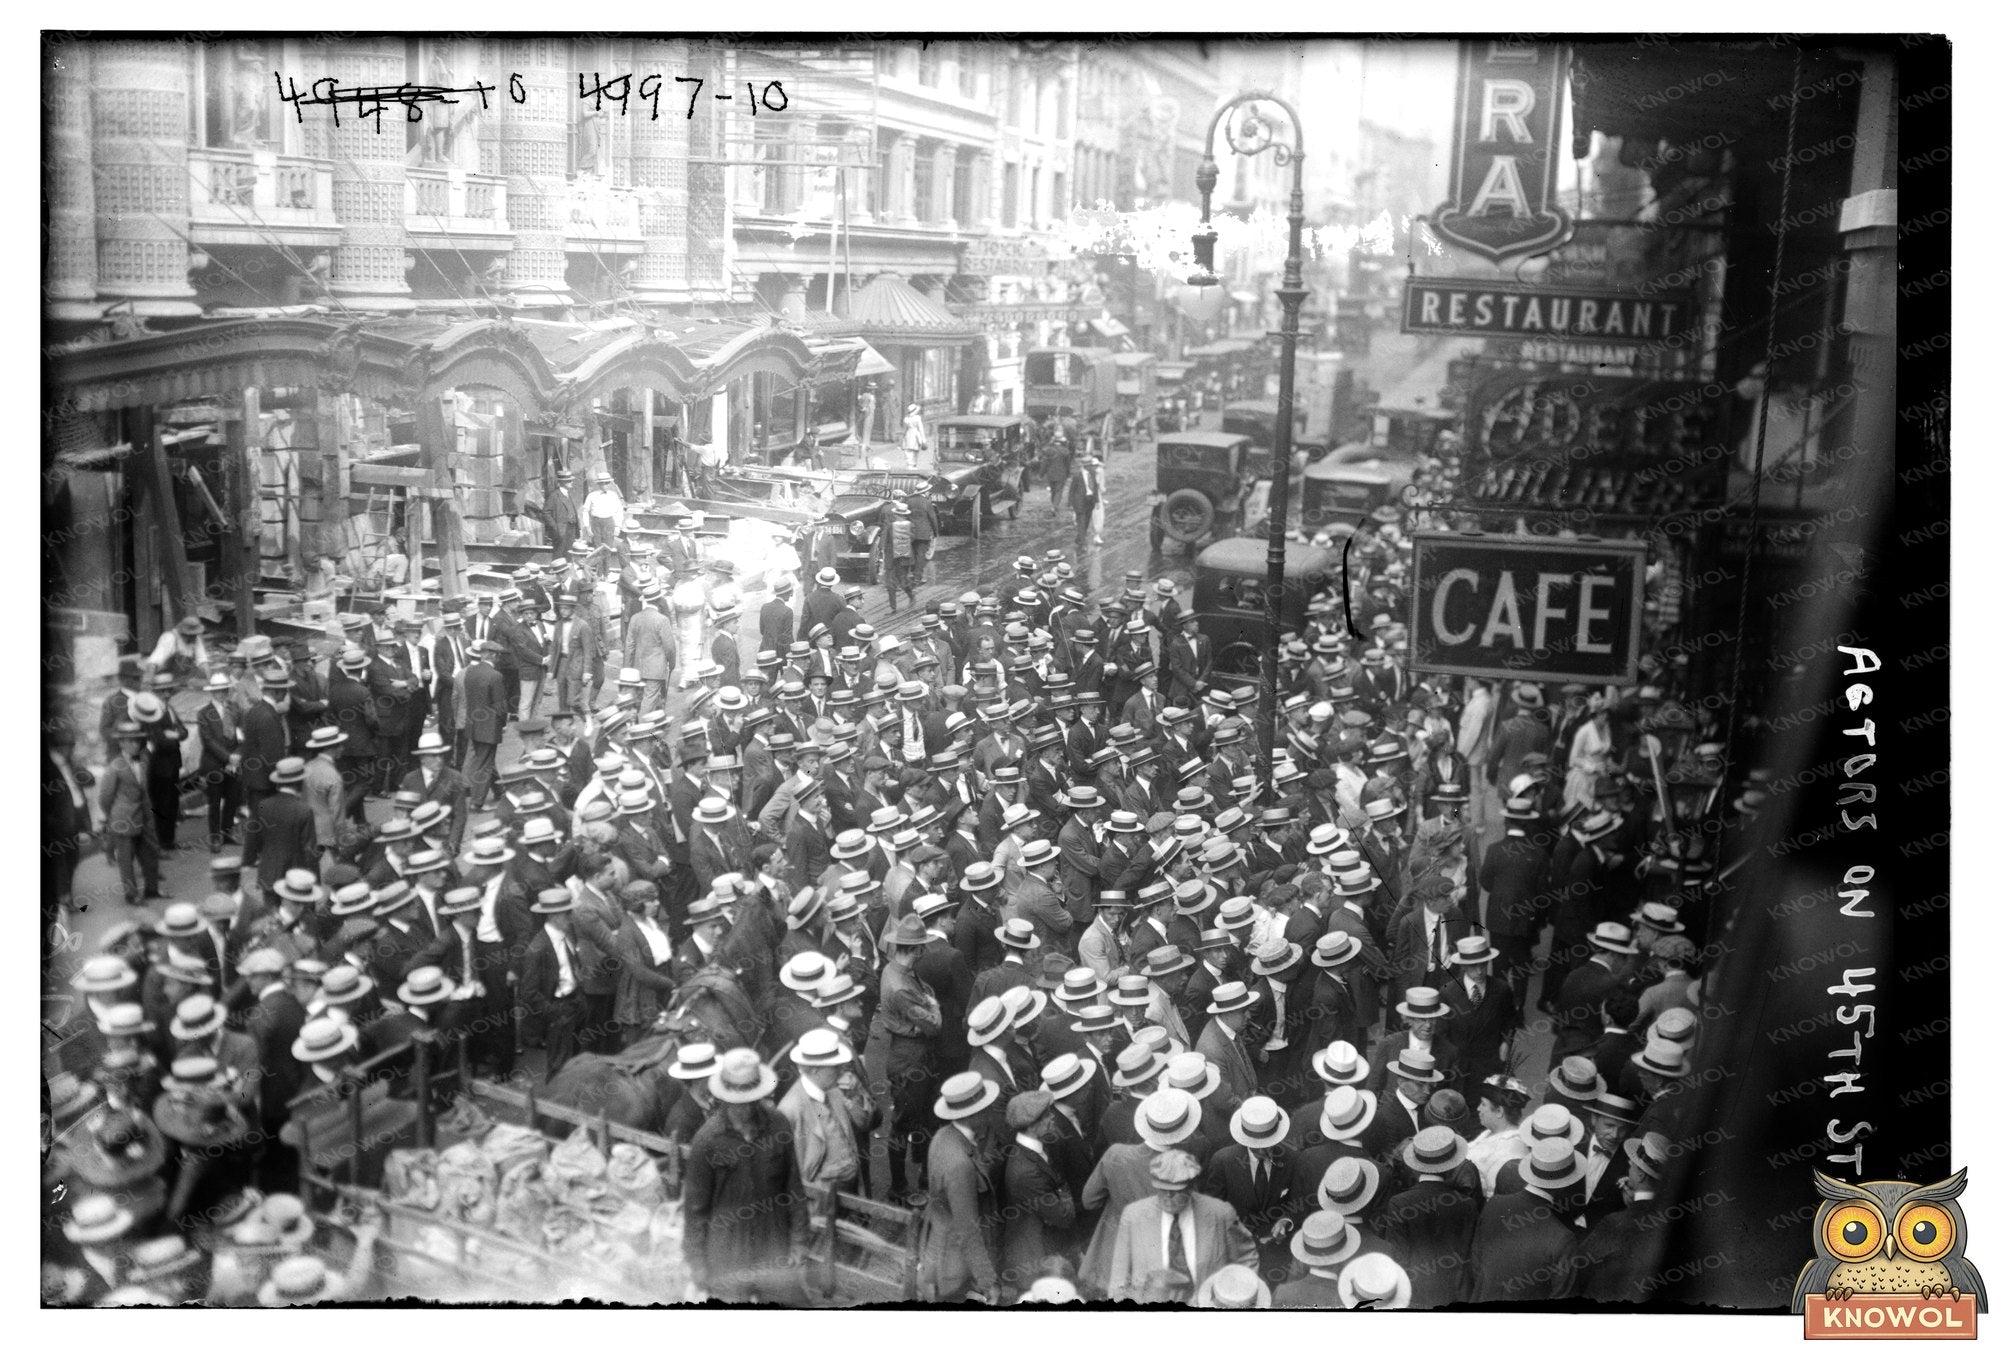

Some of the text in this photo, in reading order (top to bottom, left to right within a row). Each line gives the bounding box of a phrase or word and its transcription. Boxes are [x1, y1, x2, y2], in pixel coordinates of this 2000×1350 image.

[579, 73, 788, 121] 4997-10
[1421, 291, 1677, 336] RESTAURANT
[1521, 341, 1638, 366] RESTAURANT
[1432, 564, 1615, 653] CAFÉ
[1837, 865, 1876, 918] ON
[1823, 967, 1877, 1099] 45TH
